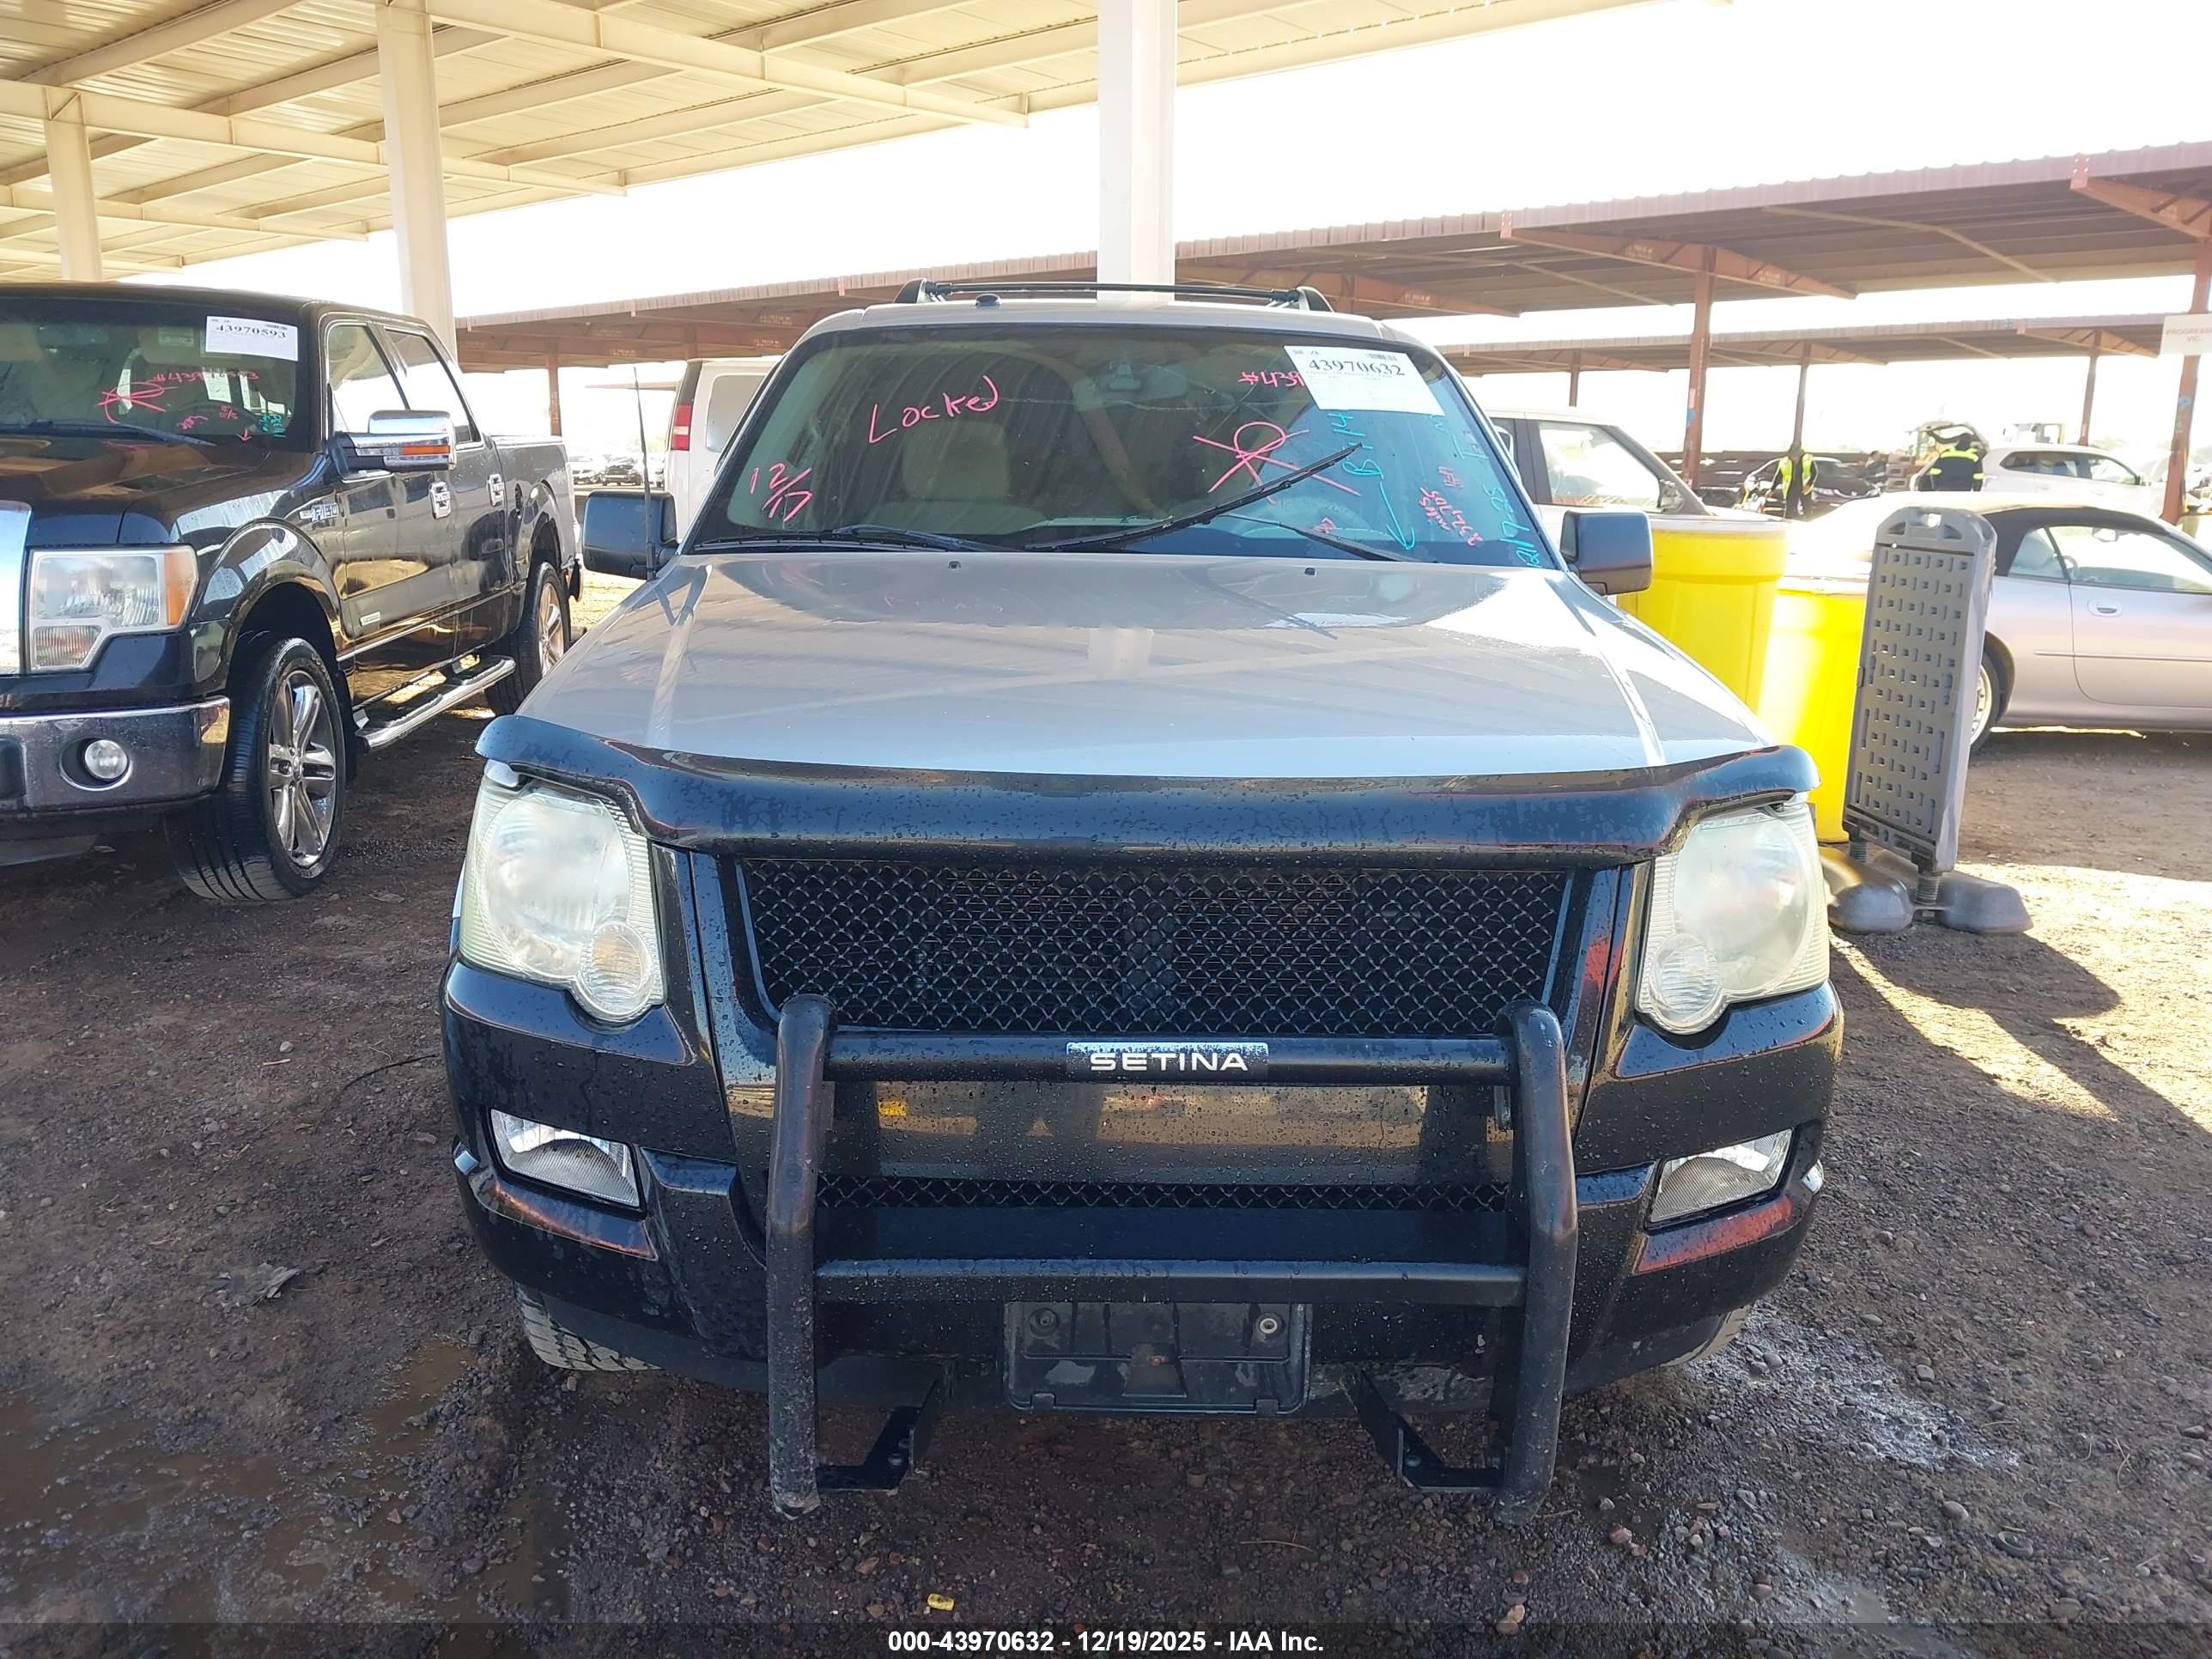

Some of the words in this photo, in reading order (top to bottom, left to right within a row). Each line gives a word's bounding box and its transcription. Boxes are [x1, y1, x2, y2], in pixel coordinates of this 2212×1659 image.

[216, 325, 287, 339] 43970593
[1309, 359, 1405, 376] 43970632
[868, 374, 999, 444] Locked
[1090, 1052, 1249, 1072] SETINA
